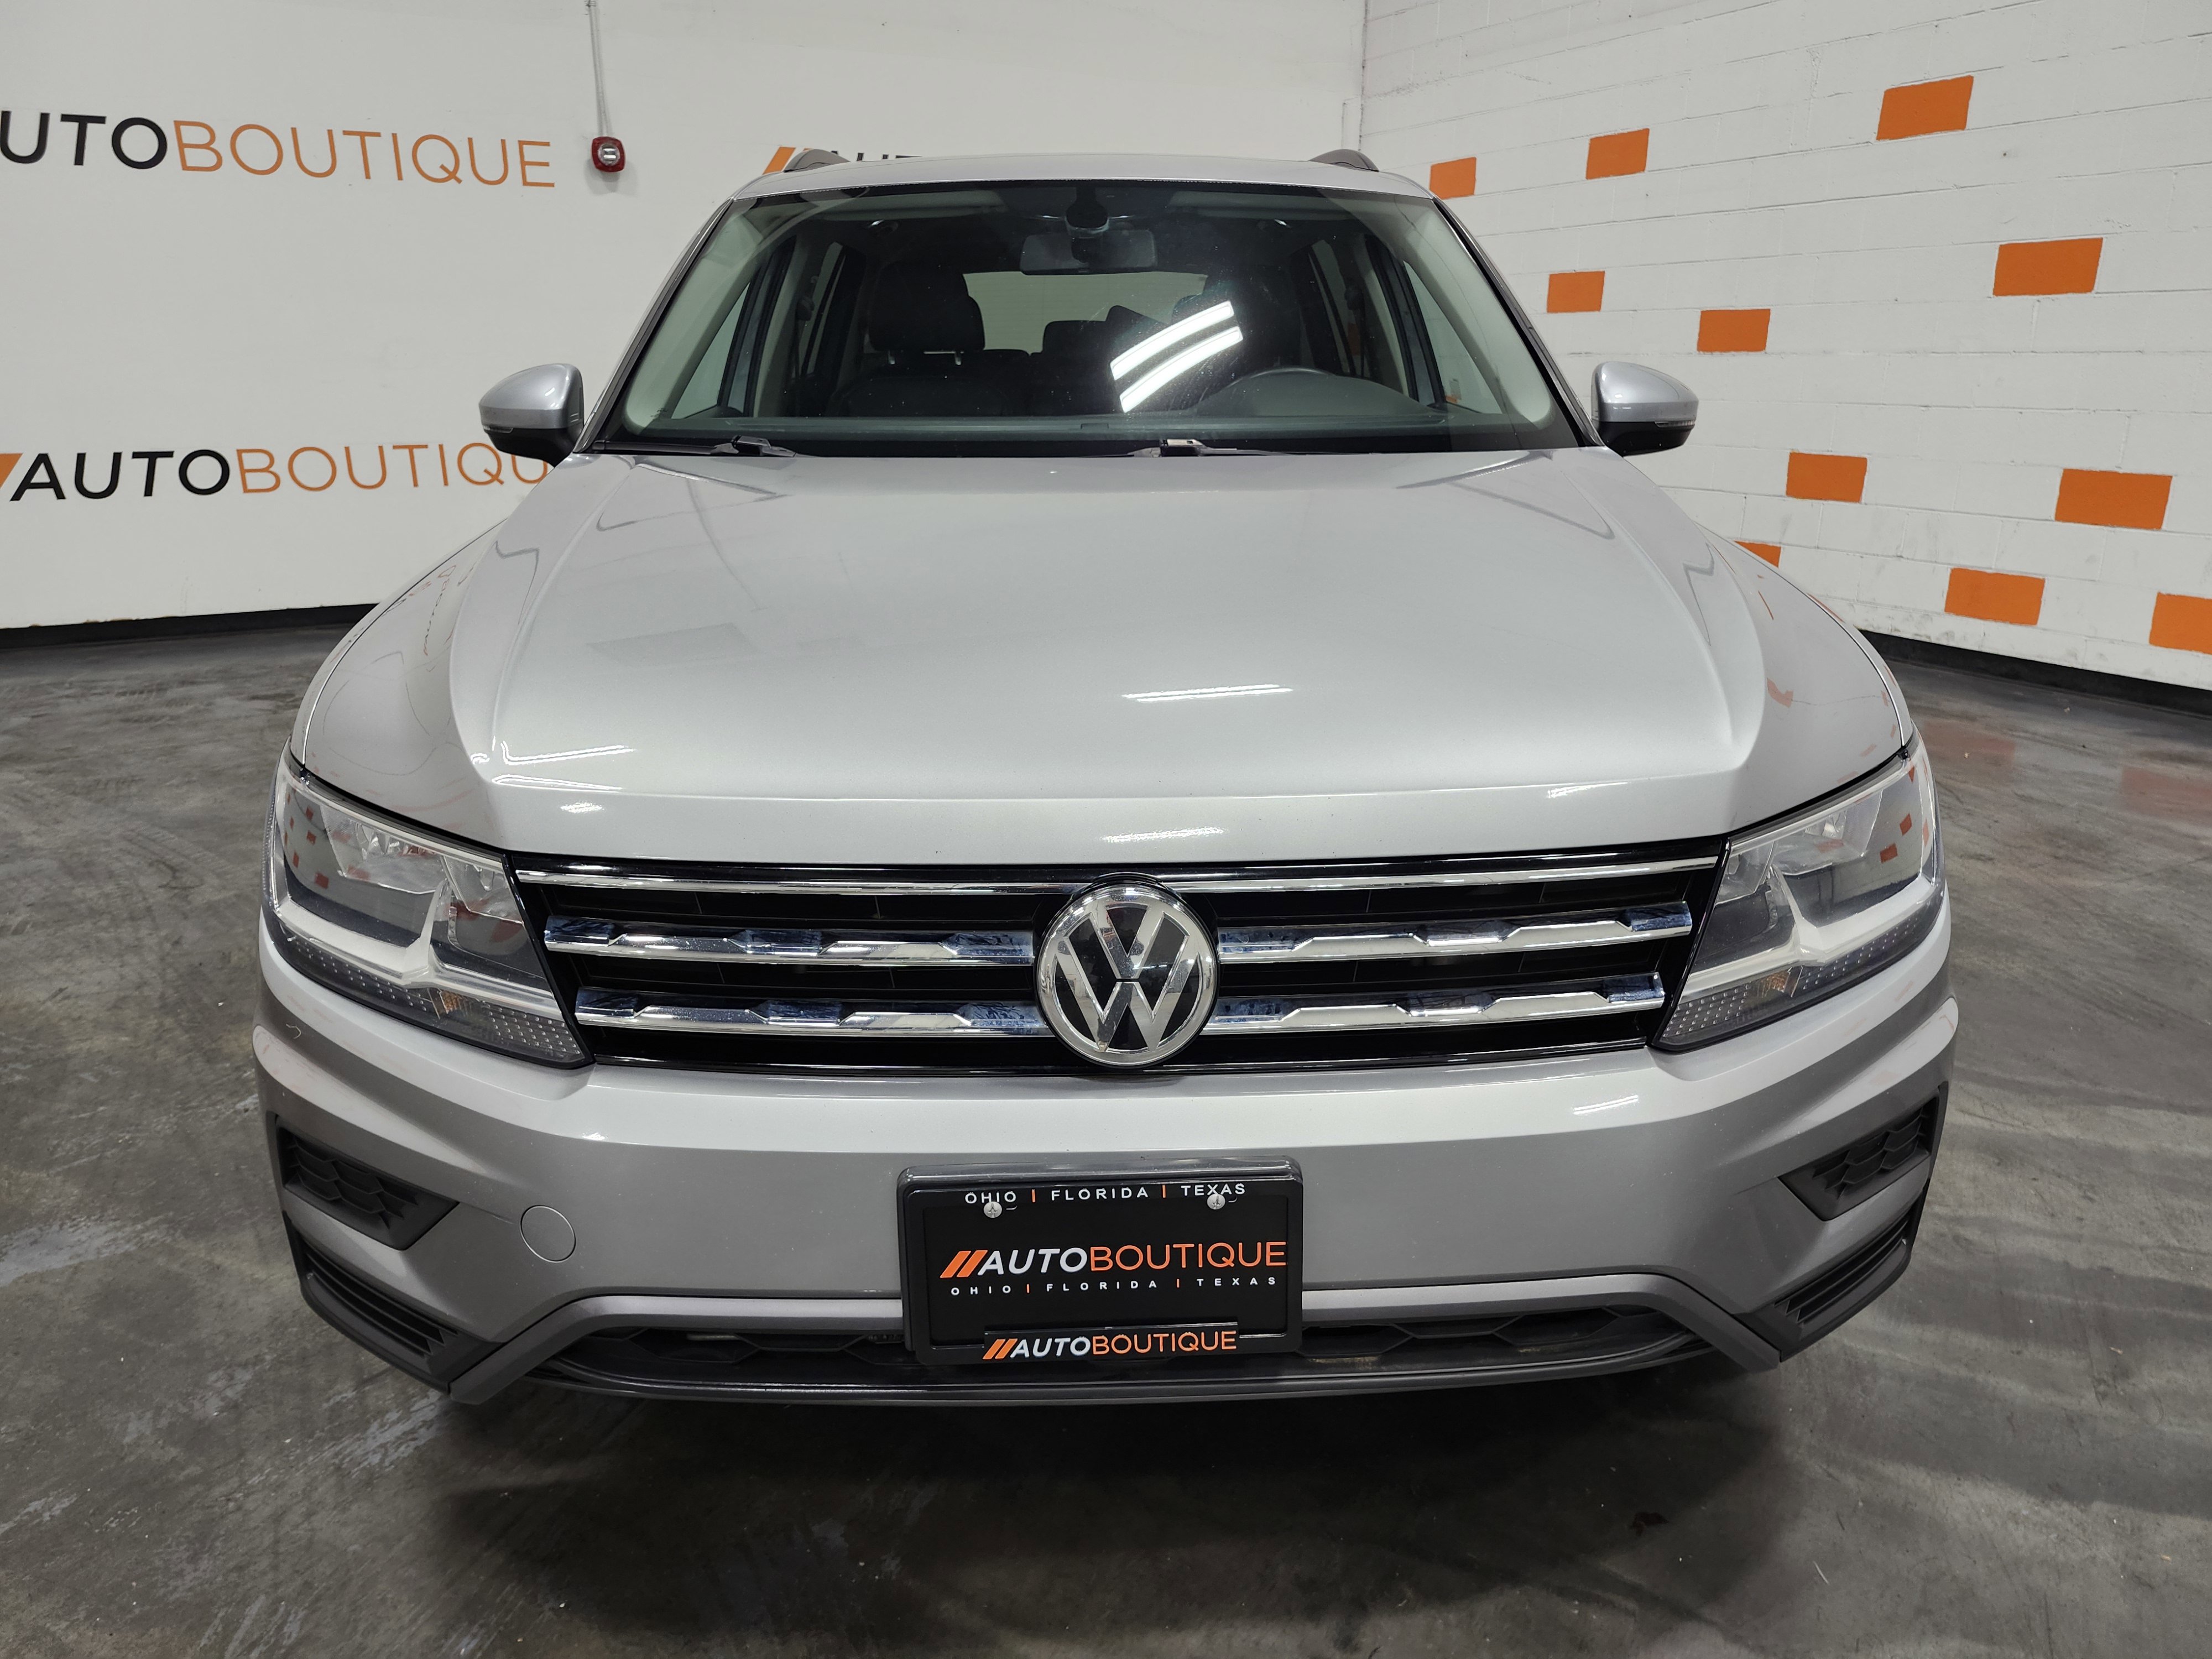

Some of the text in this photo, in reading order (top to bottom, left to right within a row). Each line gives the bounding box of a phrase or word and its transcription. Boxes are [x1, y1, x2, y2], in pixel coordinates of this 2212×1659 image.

[0, 110, 555, 187] UTOBOUTIQUE
[10, 442, 549, 502] AUTOBOUTIQU
[964, 1183, 1245, 1204] OHIO FLORIDA TEXAS
[951, 1276, 1276, 1296] OHIO FLORIDA TEXAS
